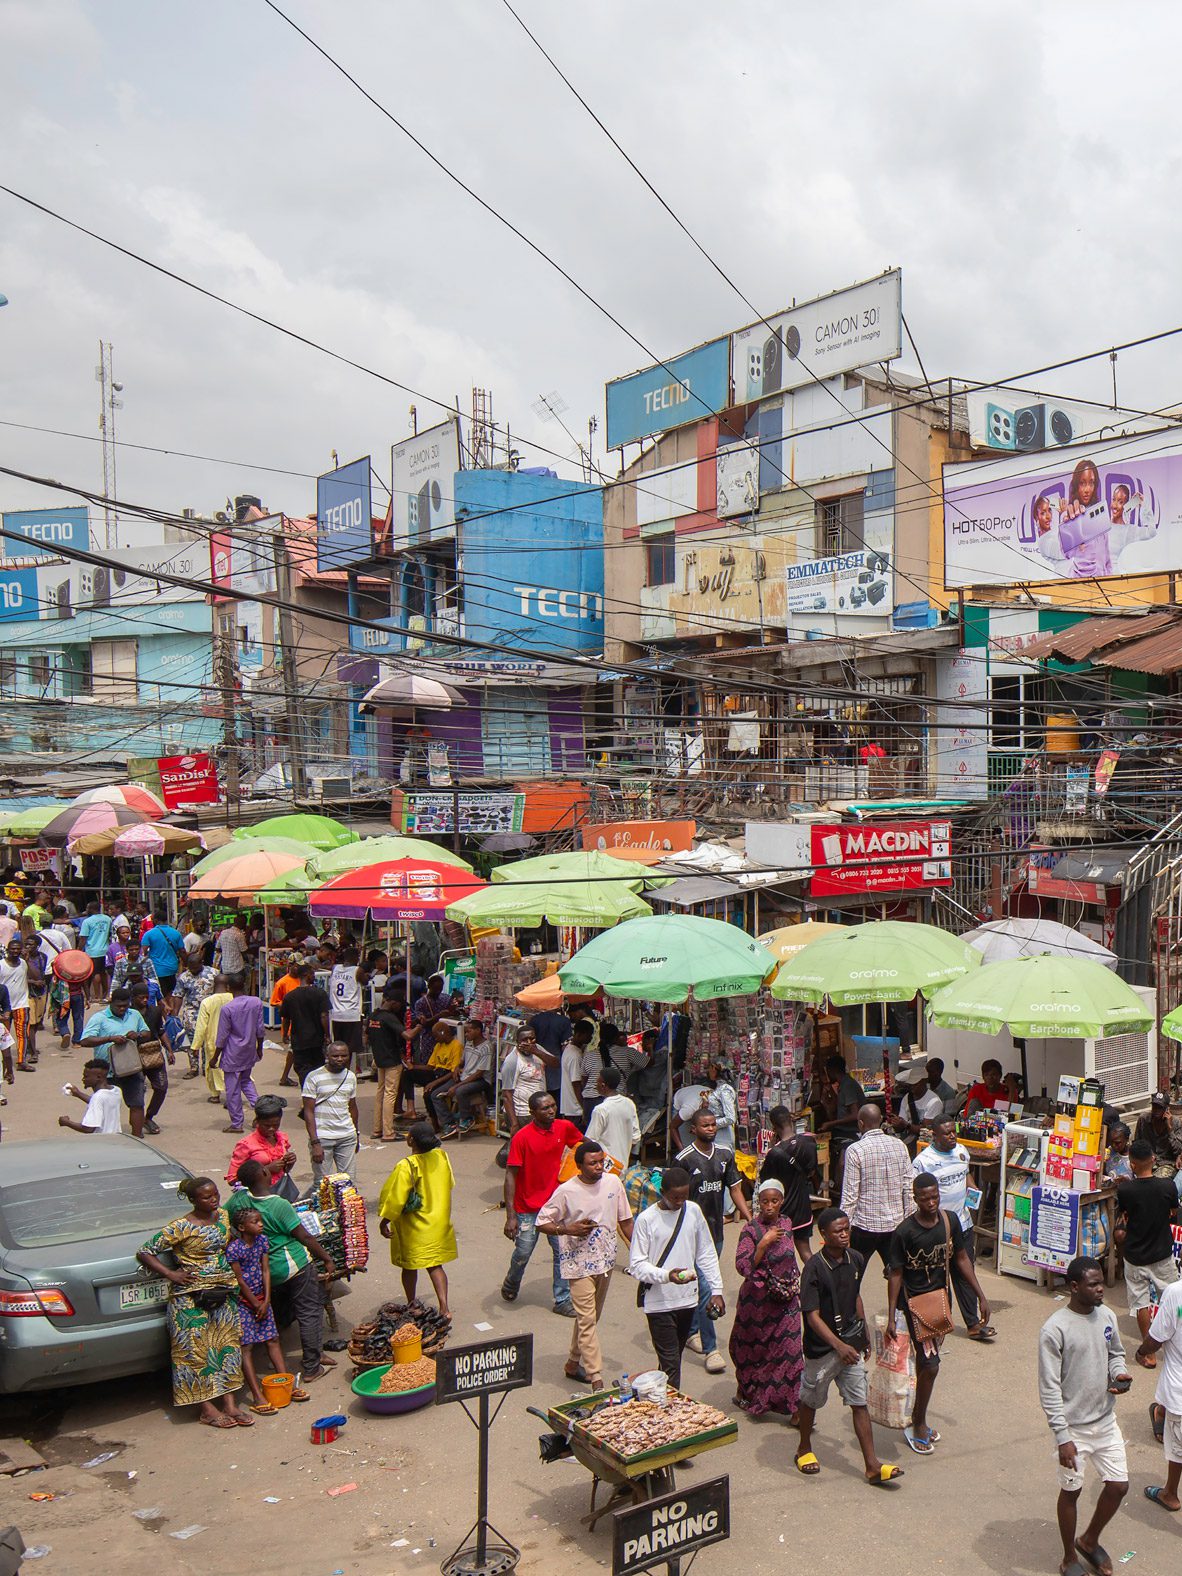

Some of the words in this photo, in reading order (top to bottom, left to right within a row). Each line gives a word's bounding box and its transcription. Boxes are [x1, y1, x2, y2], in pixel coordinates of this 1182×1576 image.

[815, 314, 858, 342] CAMON
[862, 308, 877, 328] 30
[643, 378, 690, 416] TECNO
[408, 447, 431, 469] CAMON
[325, 498, 362, 534] TECNO
[20, 522, 73, 541] TECNO
[786, 553, 865, 580] EMMATECH
[845, 829, 929, 855] MACDIN
[22, 849, 48, 864] POS
[559, 915, 604, 925] Bluetooth
[640, 956, 668, 965] Future
[849, 969, 899, 979] oraimo
[336, 983, 345, 997] 8
[1030, 1003, 1081, 1013] oraimo
[1029, 1023, 1081, 1035] Earphone
[698, 1180, 722, 1193] Jeep
[1041, 1187, 1070, 1202] POS
[455, 1356, 472, 1375] NO
[473, 1345, 517, 1372] PARKING
[456, 1372, 482, 1391] POLICE
[651, 1500, 688, 1527] NO
[623, 1510, 719, 1565] PARKING
